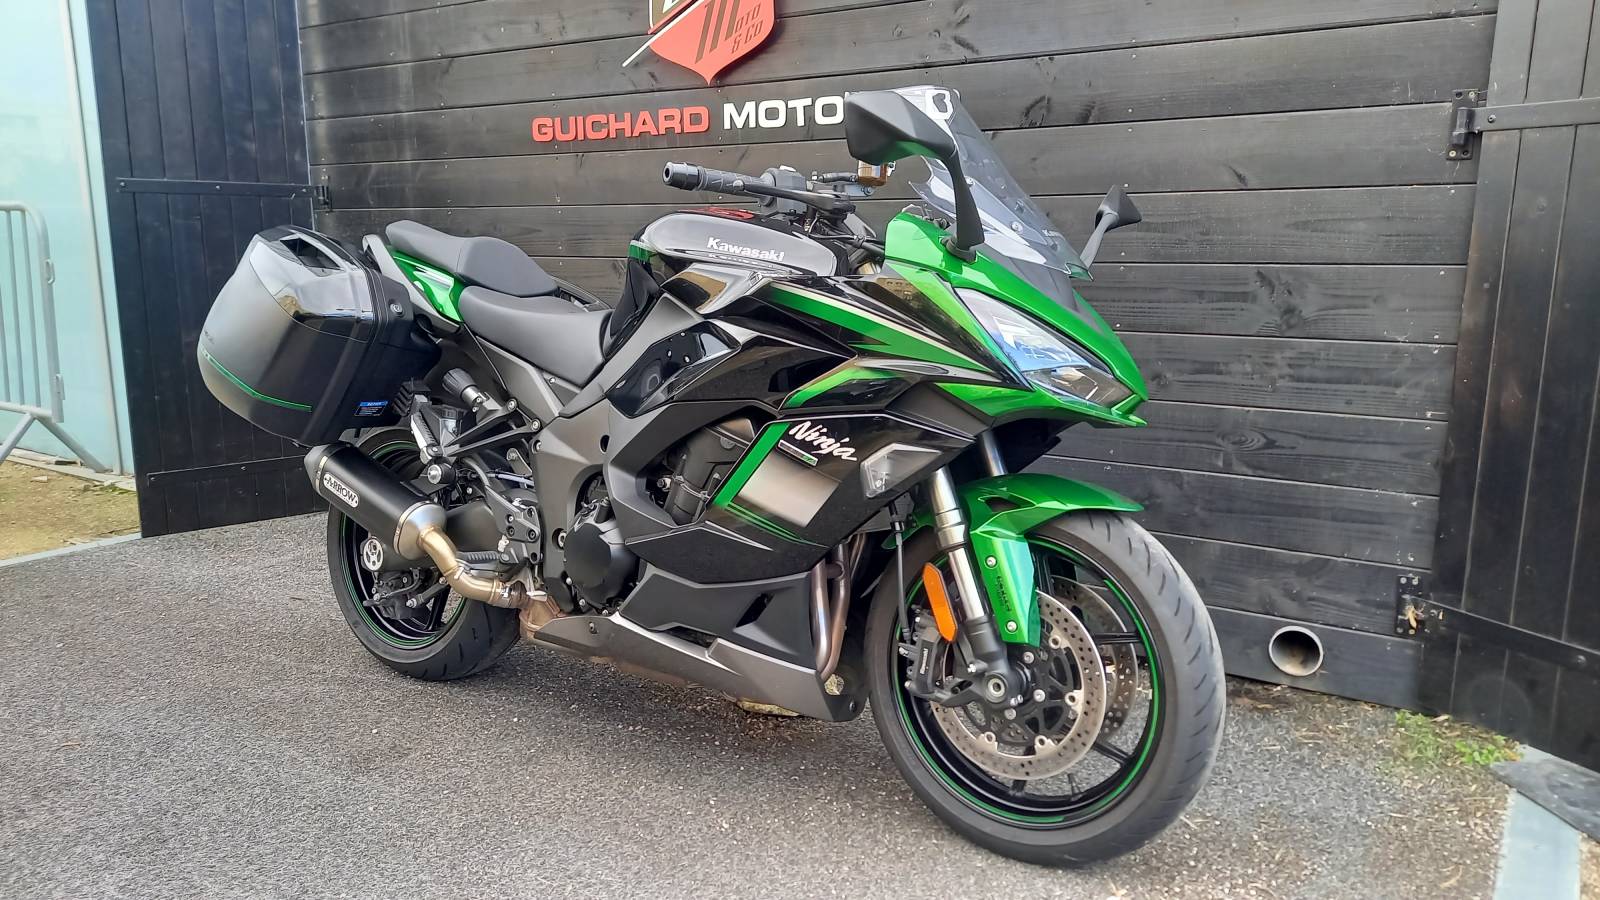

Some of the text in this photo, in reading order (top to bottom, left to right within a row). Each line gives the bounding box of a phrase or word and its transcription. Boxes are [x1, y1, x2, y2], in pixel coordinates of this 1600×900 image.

[531, 91, 851, 143] GUICHARD MOTO
[706, 236, 785, 262] Kawasaki
[788, 420, 858, 462] Ninja
[324, 475, 358, 504] ARROW
